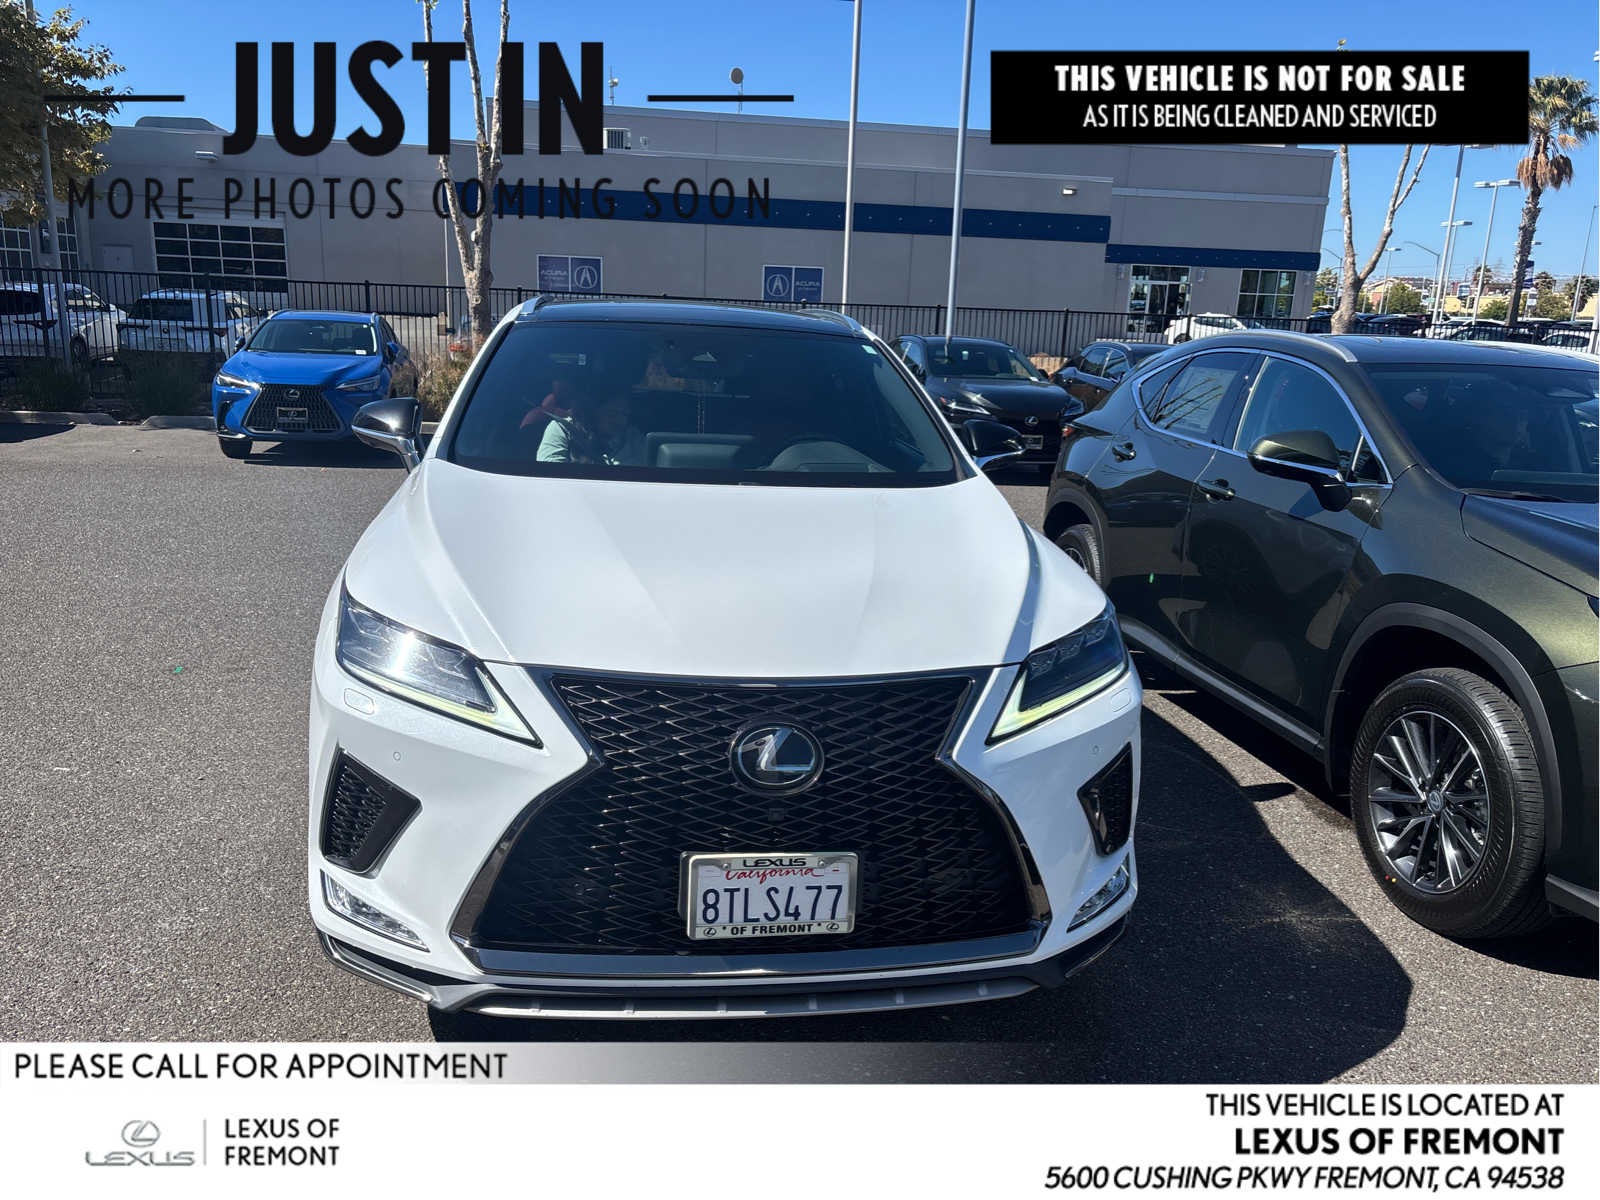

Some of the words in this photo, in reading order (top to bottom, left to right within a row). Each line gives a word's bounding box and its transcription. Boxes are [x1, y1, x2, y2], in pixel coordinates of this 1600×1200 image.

[742, 857, 807, 868] LEXUS
[702, 884, 843, 925] 8TLS477
[730, 925, 747, 936] OF
[752, 923, 814, 935] FREMONT
